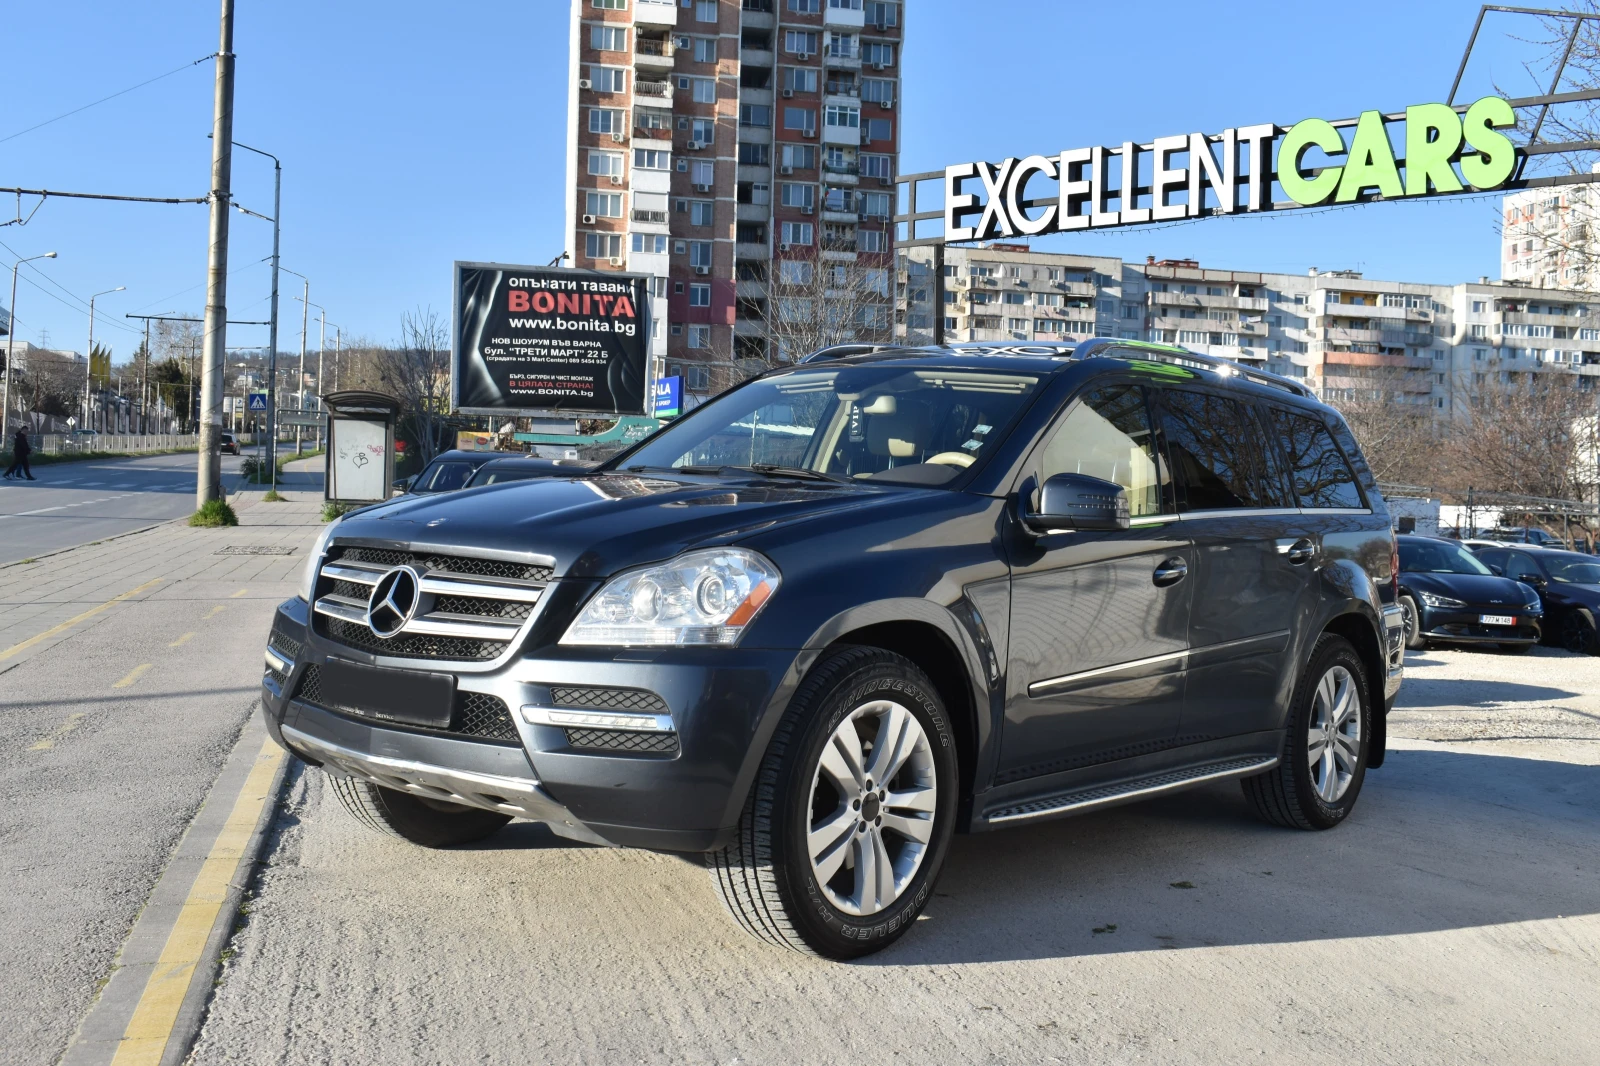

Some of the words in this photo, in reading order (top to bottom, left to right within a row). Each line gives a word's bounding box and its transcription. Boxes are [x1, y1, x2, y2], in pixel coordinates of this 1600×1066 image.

[944, 122, 1275, 242] EXCELLENT
[1277, 96, 1516, 205] CARS
[508, 277, 577, 291] опънати
[581, 281, 633, 293] тавани
[508, 290, 635, 318] BONITA
[508, 317, 636, 337] www.bonita.bg
[491, 337, 511, 345] НОВ
[512, 338, 550, 346] ШОУРУМ
[552, 339, 571, 347] ВЪВ
[573, 340, 602, 348] ВАРНА
[484, 347, 507, 355] бул.
[587, 350, 598, 358] 22
[601, 350, 609, 358] Б
[509, 388, 594, 398] www.BONITA.bg
[840, 881, 929, 941] DUELER
